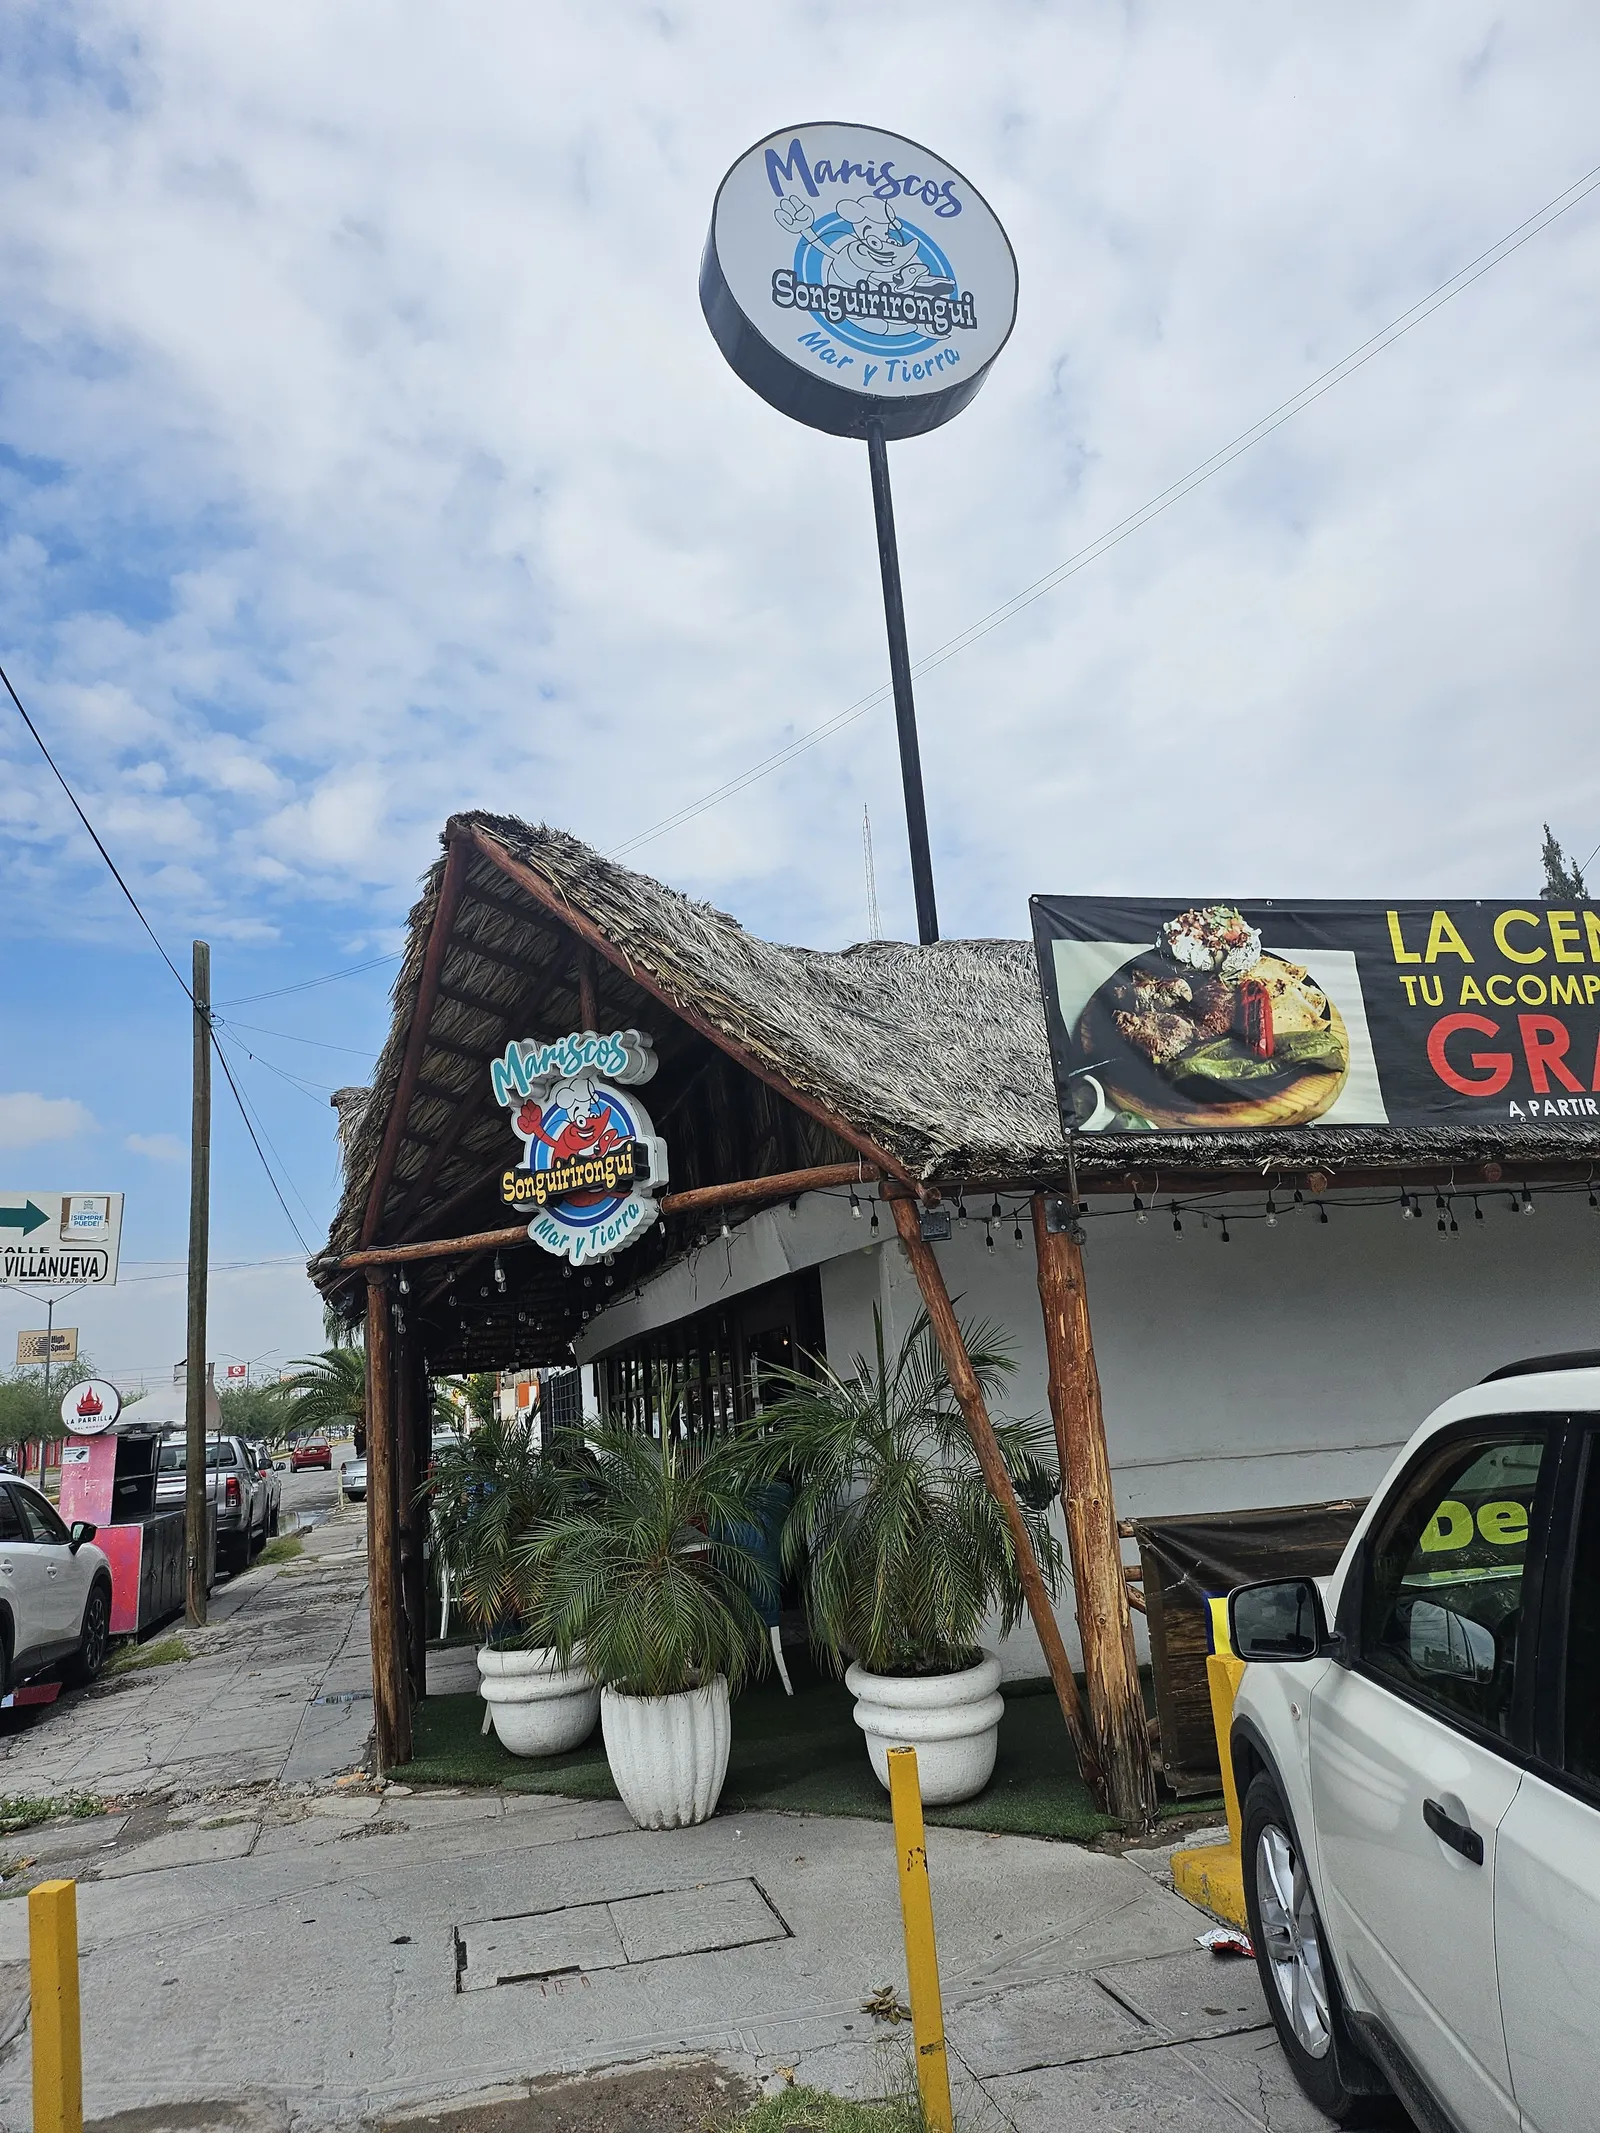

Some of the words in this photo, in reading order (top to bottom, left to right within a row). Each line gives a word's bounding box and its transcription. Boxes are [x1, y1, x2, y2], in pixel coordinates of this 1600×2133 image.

[764, 138, 962, 218] Mariscos
[772, 269, 977, 335] Songuirirongui
[797, 331, 853, 370] Mar
[863, 363, 878, 387] y
[885, 347, 961, 383] Tierra
[1386, 910, 1475, 964] LA
[1399, 975, 1444, 1007] TU
[491, 1032, 628, 1106] Mariscos
[1426, 1012, 1600, 1097] GR
[1509, 1100, 1526, 1117] A
[1528, 1098, 1600, 1117] PARTIR
[502, 1144, 634, 1205] Songuirirongui
[534, 1217, 569, 1249] Mar
[575, 1236, 586, 1259] y
[589, 1202, 640, 1250] Tierra
[5, 1257, 98, 1277] VILLANUEVA
[51, 1335, 65, 1344] High
[51, 1343, 70, 1352] Speed
[78, 1415, 112, 1423] PARRILLA
[1420, 1500, 1533, 1552] De
